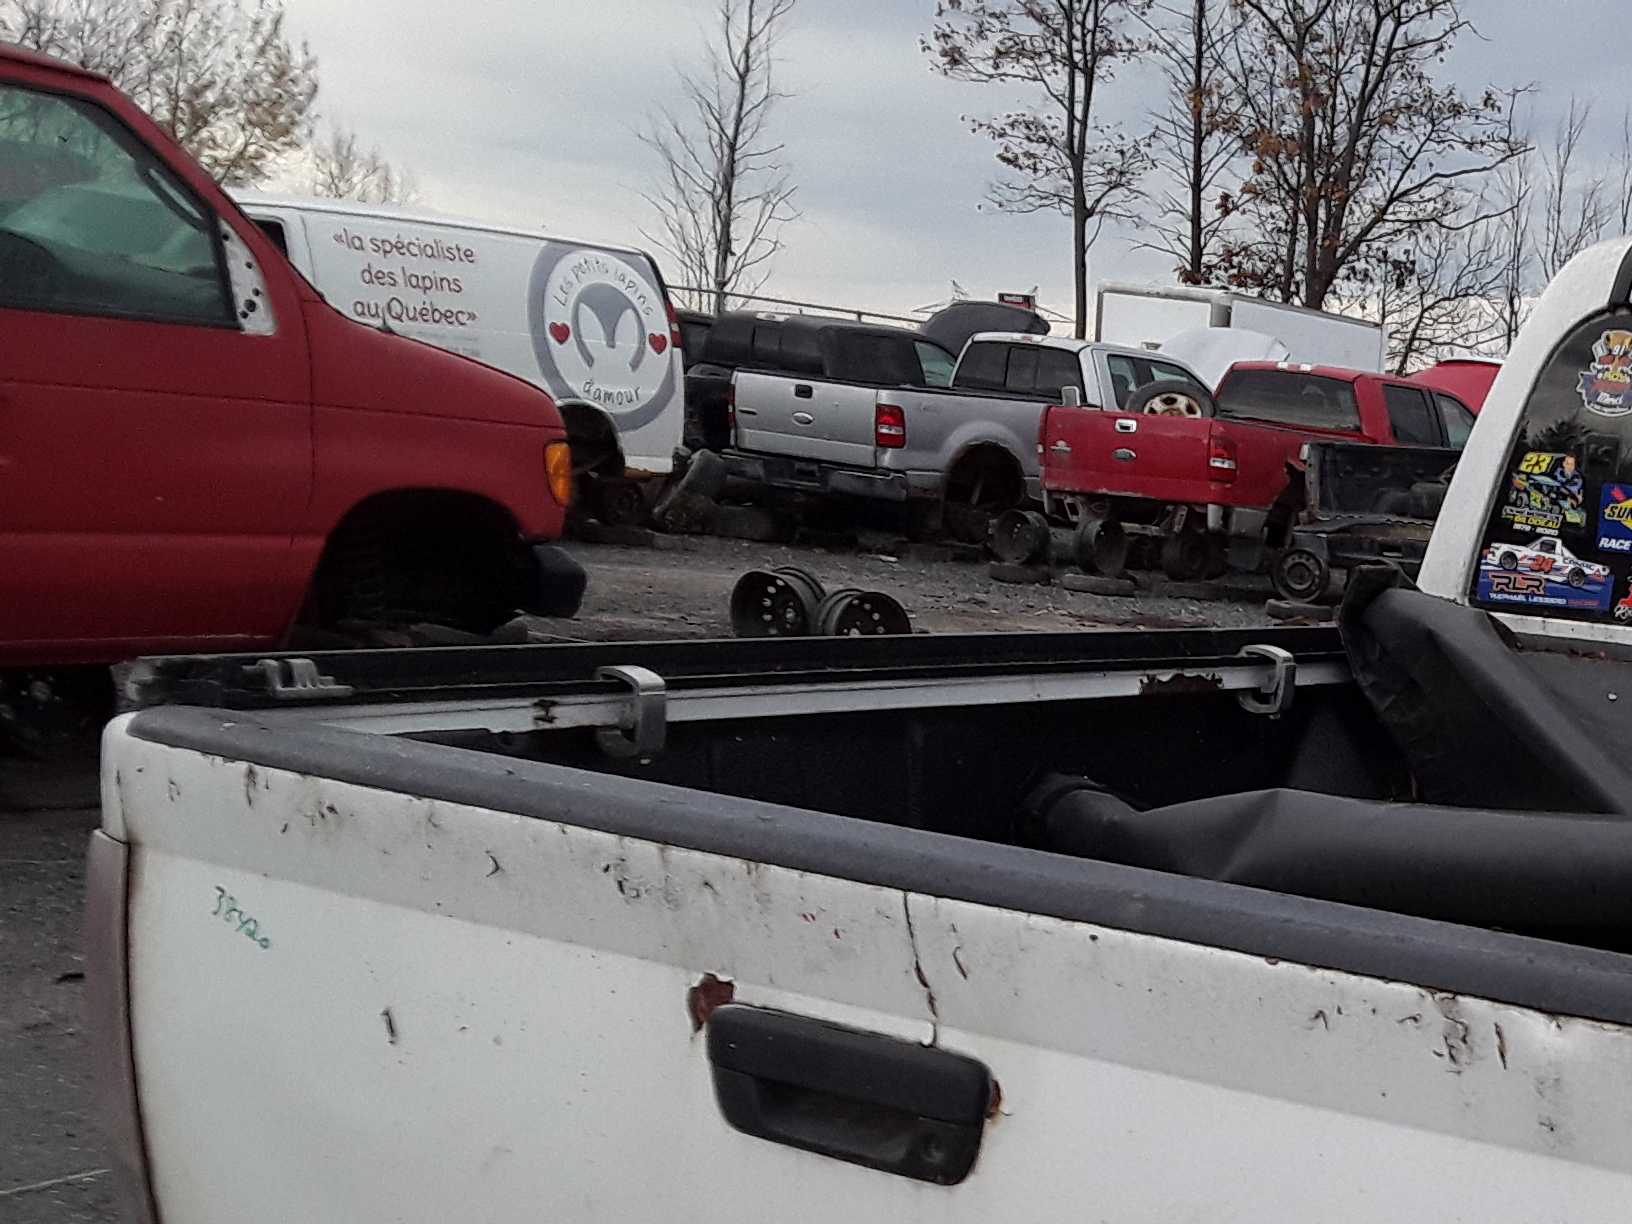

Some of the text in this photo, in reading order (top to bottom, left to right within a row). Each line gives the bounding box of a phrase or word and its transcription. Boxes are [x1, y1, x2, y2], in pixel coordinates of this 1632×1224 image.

[369, 232, 476, 264] spécialiste
[361, 263, 463, 295] des lapins
[553, 257, 654, 318] Les petits lapins
[353, 300, 380, 319] au
[1519, 452, 1553, 474] 23
[1599, 537, 1631, 551] RACE
[1488, 572, 1546, 595] RLR
